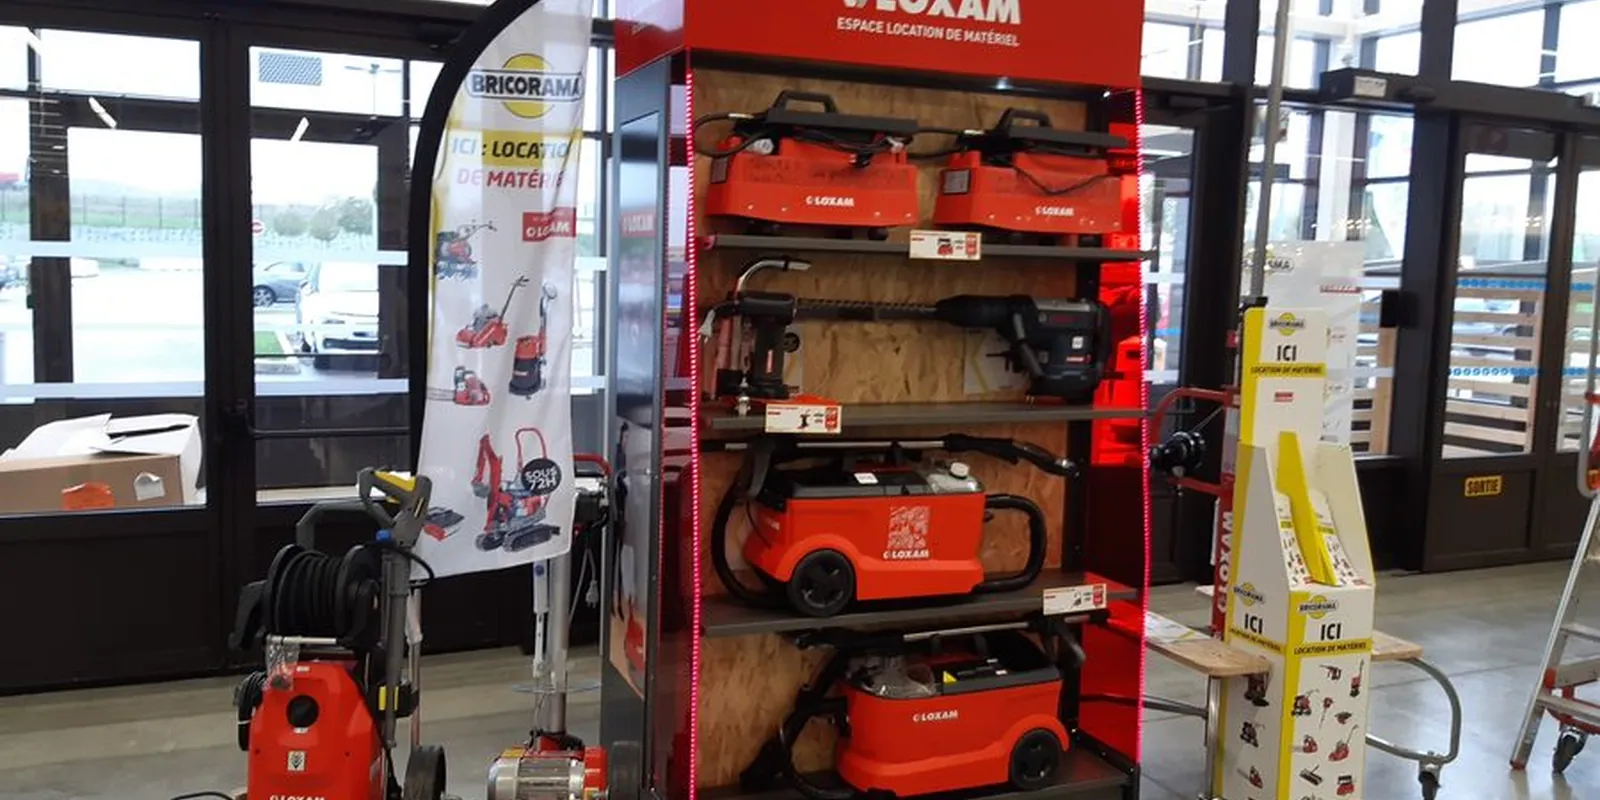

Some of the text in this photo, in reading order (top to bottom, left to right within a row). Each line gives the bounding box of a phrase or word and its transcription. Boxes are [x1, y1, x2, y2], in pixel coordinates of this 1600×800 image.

[836, 17, 1020, 47] ESPACE LOCATION DE MATÉRIEL
[471, 74, 580, 97] BRICORAMA
[452, 137, 476, 155] ICI
[457, 168, 483, 186] DE
[815, 196, 855, 208] LOXAM
[1042, 206, 1075, 217] LOXAM
[1276, 345, 1297, 361] ICI
[525, 466, 557, 482] SOUS
[529, 475, 556, 491] 72H
[1467, 479, 1499, 494] SORTIE
[891, 549, 930, 560] LOXAM
[1244, 613, 1263, 635] ICI
[1320, 623, 1342, 641] ICI
[1294, 646, 1326, 656] LOCATION
[921, 709, 958, 721] LOXAM
